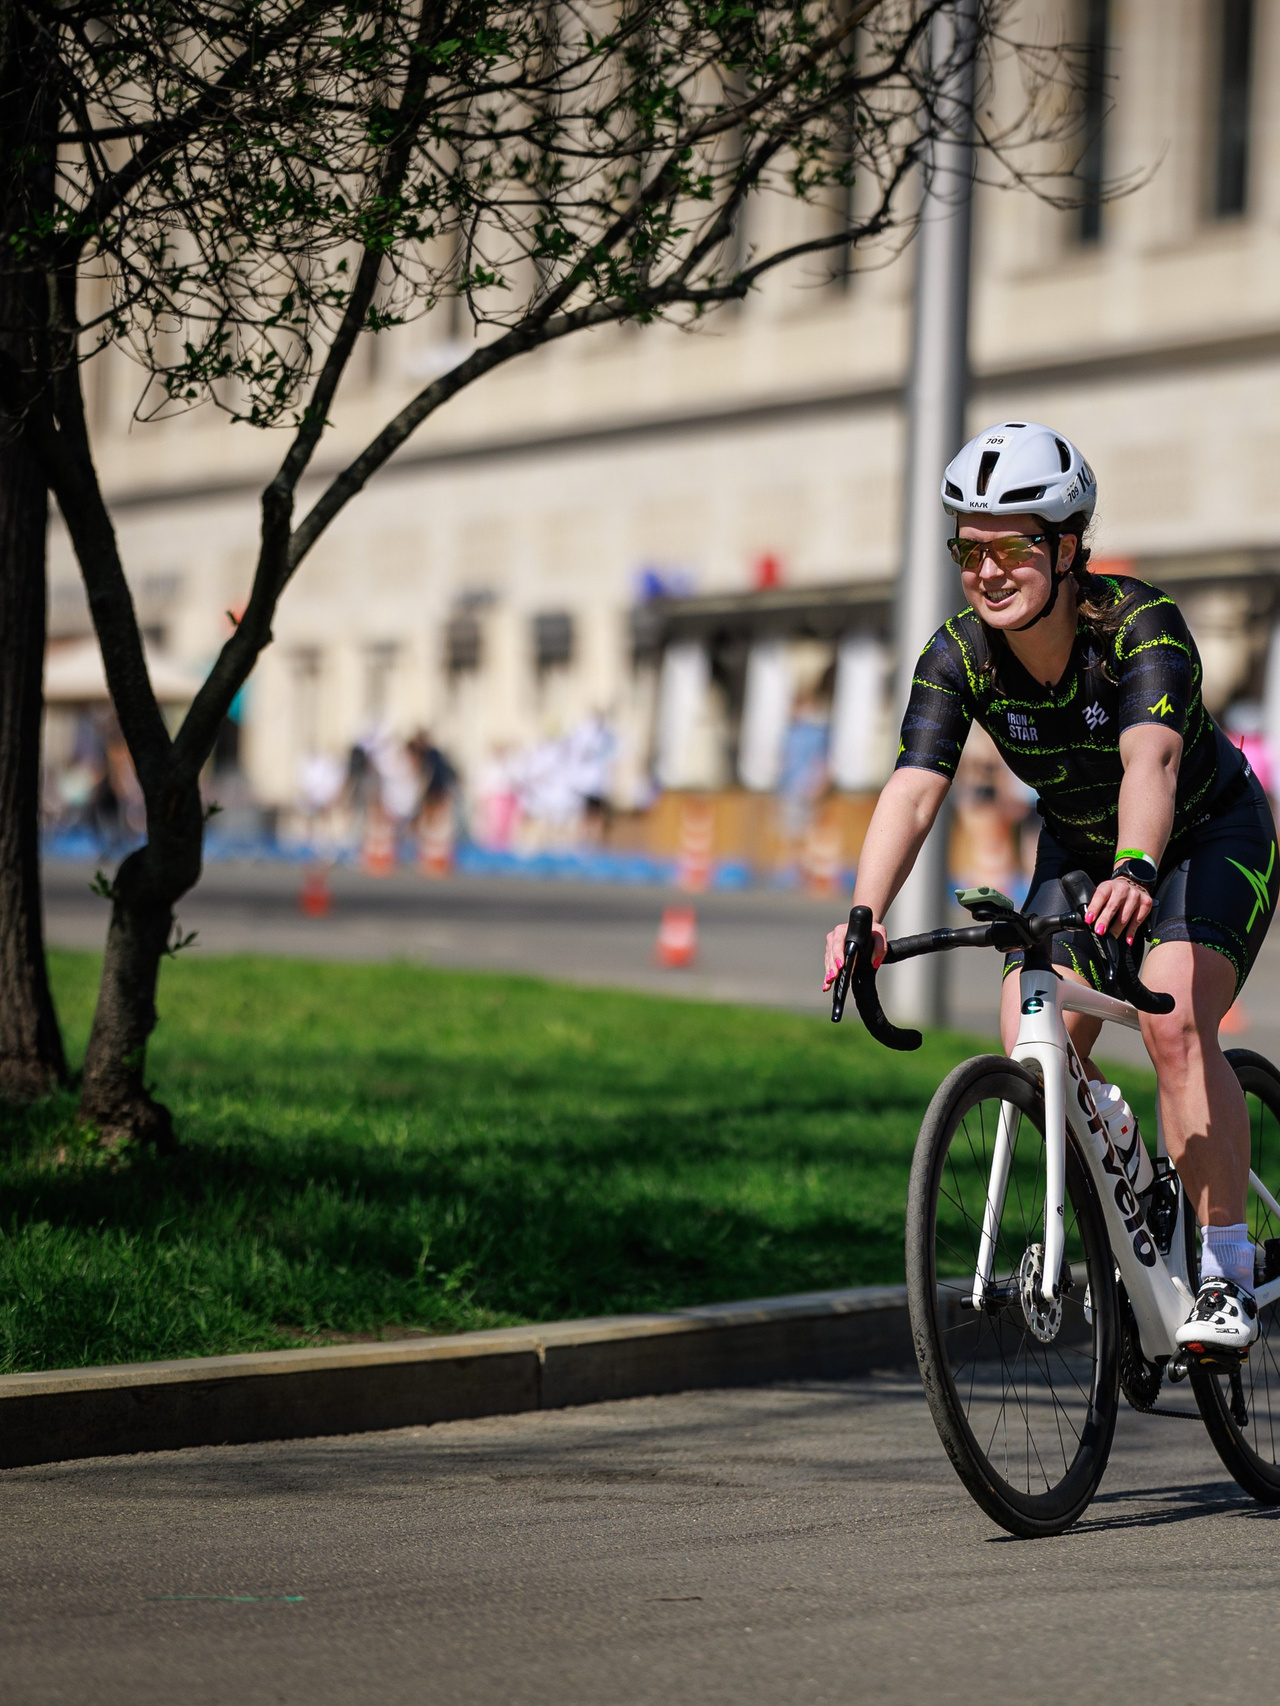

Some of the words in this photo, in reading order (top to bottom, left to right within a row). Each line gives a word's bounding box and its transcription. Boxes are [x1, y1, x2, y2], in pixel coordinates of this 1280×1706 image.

[1067, 486, 1080, 503] 709
[1007, 712, 1028, 726] IRON
[1009, 725, 1039, 741] STAR
